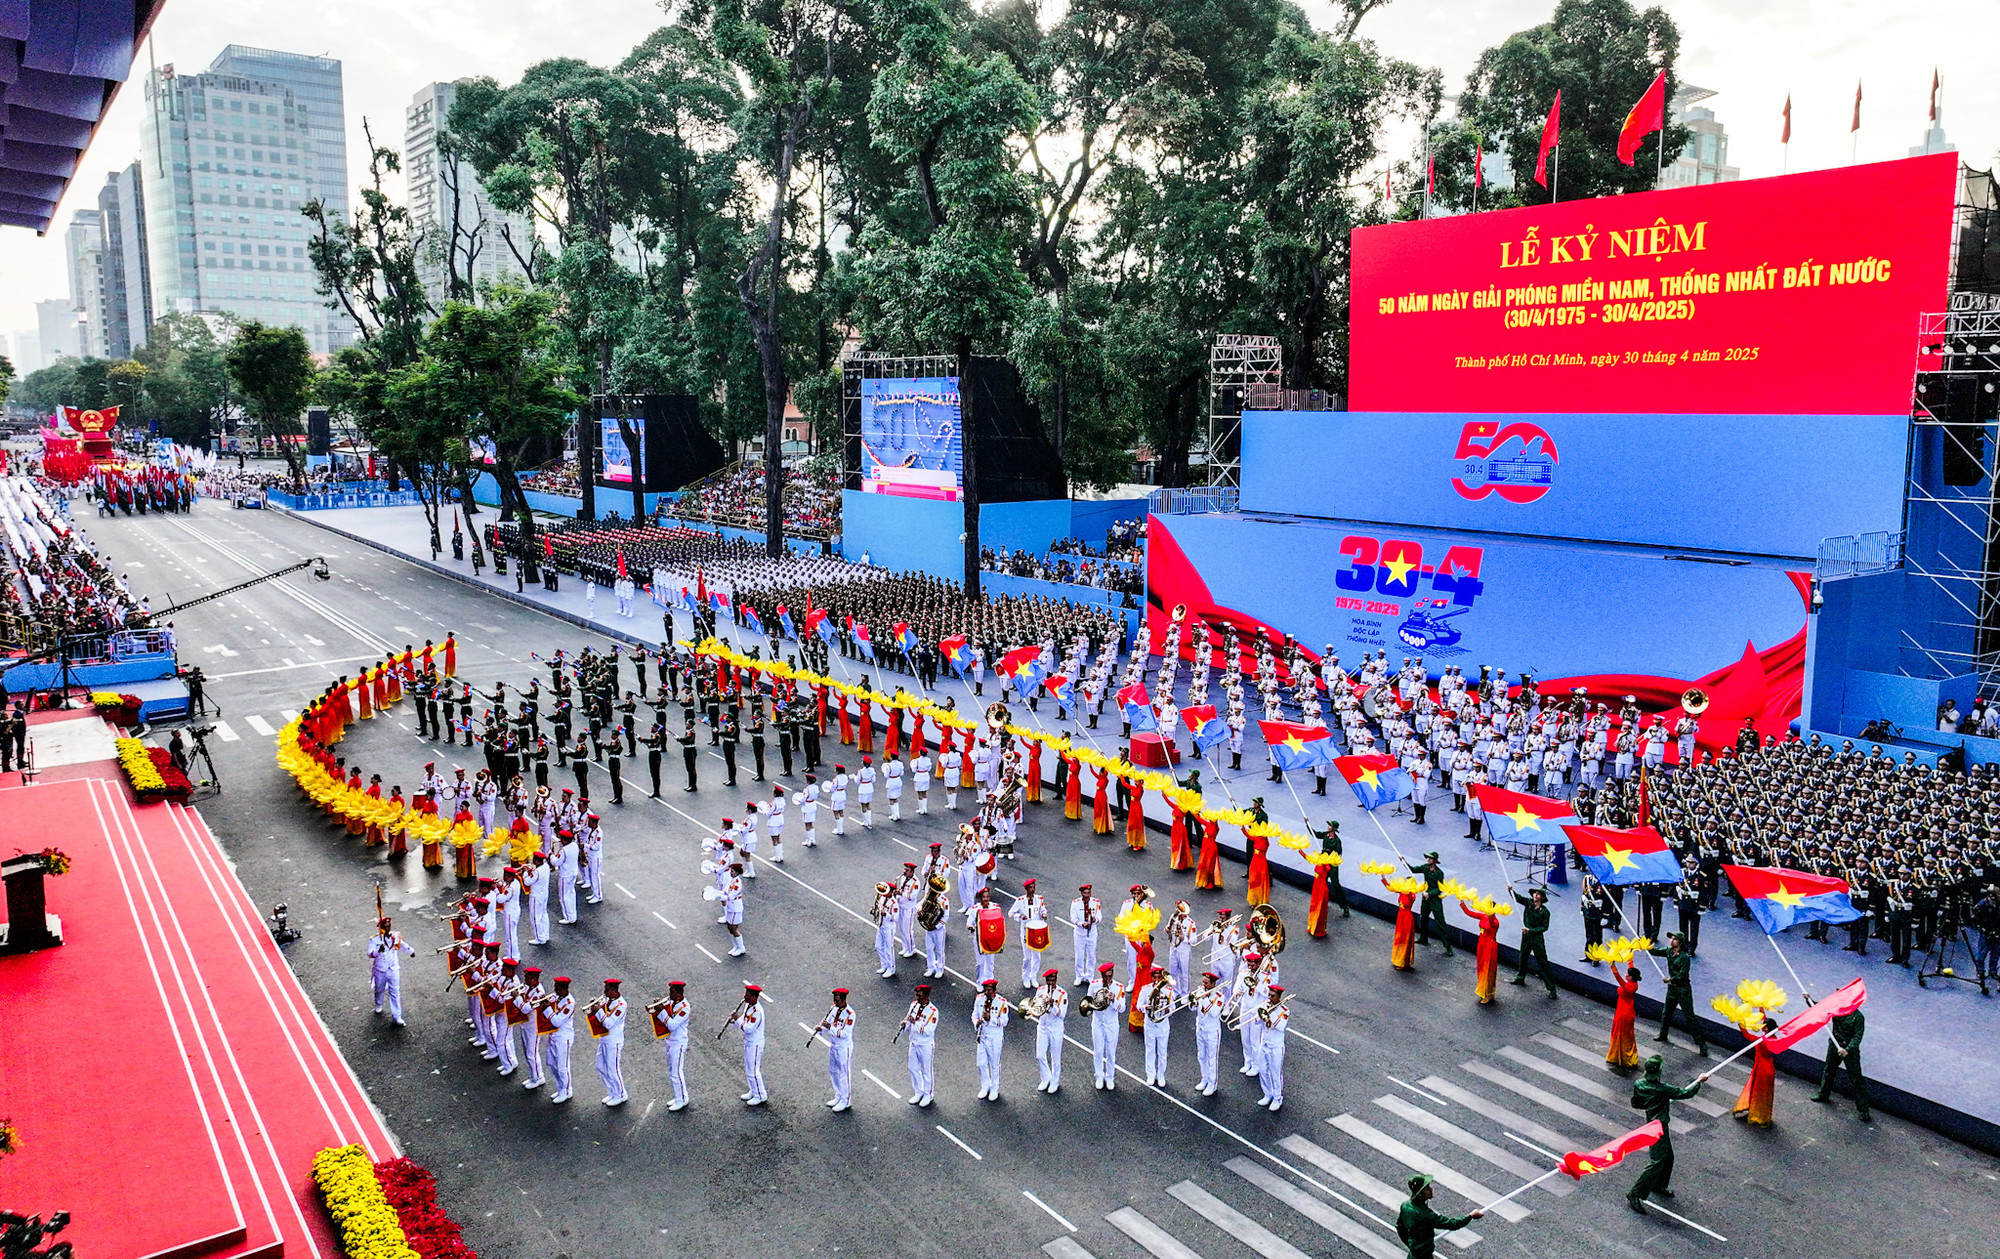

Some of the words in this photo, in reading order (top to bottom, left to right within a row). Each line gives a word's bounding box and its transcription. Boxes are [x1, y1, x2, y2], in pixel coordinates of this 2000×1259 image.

[1500, 226, 1540, 268] LỄ
[1550, 224, 1599, 263] KỶ
[1608, 217, 1707, 263] NIỆM
[1379, 298, 1395, 315] 50
[1399, 293, 1428, 314] NĂM
[1432, 289, 1469, 312] NGÀY
[1473, 284, 1501, 309] GIẢI
[1506, 283, 1557, 306] PHÓNG
[1562, 277, 1604, 304] MIỀN
[1609, 279, 1654, 301] NAM,
[1660, 267, 1720, 296] THỐNG
[1726, 261, 1777, 292] NHẤT
[1783, 257, 1823, 289] ĐẤT
[1830, 256, 1891, 285] NƯỚC
[1505, 307, 1585, 331] (30/4/1975
[1603, 299, 1695, 323] 30/4/2025)
[1455, 356, 1486, 368] Thành
[1488, 354, 1510, 370] phố
[1511, 353, 1527, 366] Hồ
[1531, 354, 1551, 366] Chí
[1553, 353, 1586, 366] Minh,
[1591, 352, 1620, 367] ngày
[1623, 352, 1638, 363] 30
[1643, 351, 1677, 365] tháng
[1681, 350, 1689, 361] 4
[1693, 350, 1720, 361] năm
[1725, 348, 1760, 361] 2025
[1451, 421, 1559, 504] 50
[1465, 464, 1484, 474] 30.4
